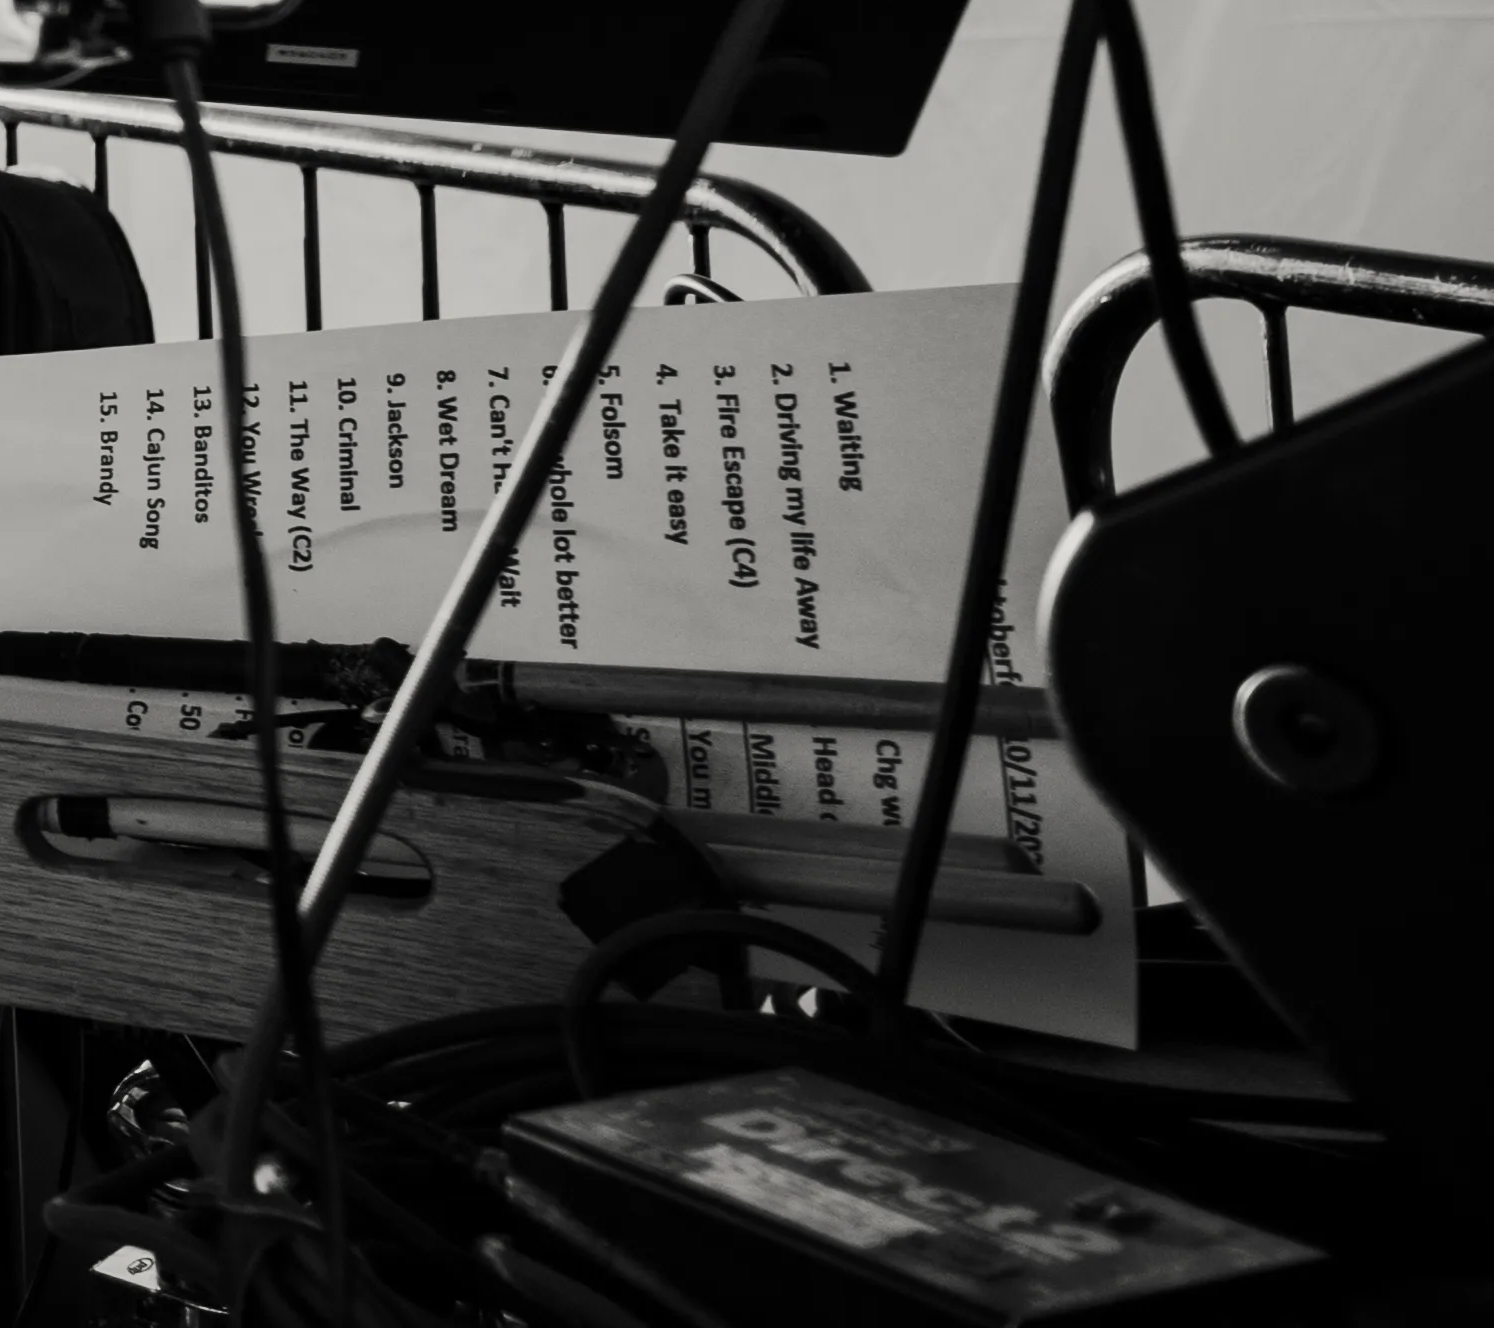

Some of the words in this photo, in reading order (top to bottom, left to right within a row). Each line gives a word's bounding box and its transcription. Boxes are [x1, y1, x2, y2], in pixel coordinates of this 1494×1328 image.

[288, 380, 308, 414] 11.
[337, 377, 357, 411] 10.
[385, 372, 406, 395] 9.
[436, 368, 456, 391] 8.
[488, 366, 510, 388] 7.
[656, 362, 679, 387] 4.
[713, 363, 736, 387] 3.
[770, 362, 794, 387] 2.
[827, 360, 851, 385] 1.
[99, 391, 118, 423] 15.
[146, 388, 165, 422] 14.
[193, 385, 212, 419] 13.
[437, 396, 458, 446] Wet
[489, 394, 514, 456] Can't
[716, 392, 741, 440] Fire
[241, 421, 261, 464] You
[289, 418, 310, 463] The
[386, 399, 408, 489] Jackson
[600, 393, 627, 480] Folsom
[659, 399, 686, 459] Take
[774, 392, 801, 482] Driving
[832, 390, 865, 493] Waiting
[93, 430, 119, 506] Brandy
[145, 427, 166, 491] Cajun
[194, 425, 214, 524] Banditos
[338, 417, 361, 512] Criminal
[666, 464, 688, 483] it
[288, 469, 311, 520] Way
[439, 451, 459, 532] Dream
[722, 445, 746, 532] Escape
[783, 486, 807, 528] my
[139, 497, 166, 551] Song
[664, 488, 689, 546] easy
[288, 524, 313, 573] (C2)
[553, 529, 577, 563] lot
[726, 536, 760, 590] (C4)
[791, 531, 820, 571] life
[556, 569, 580, 650] better
[795, 578, 820, 650] Away
[688, 729, 713, 781] You
[812, 735, 845, 807] Head
[872, 738, 903, 790] Chg
